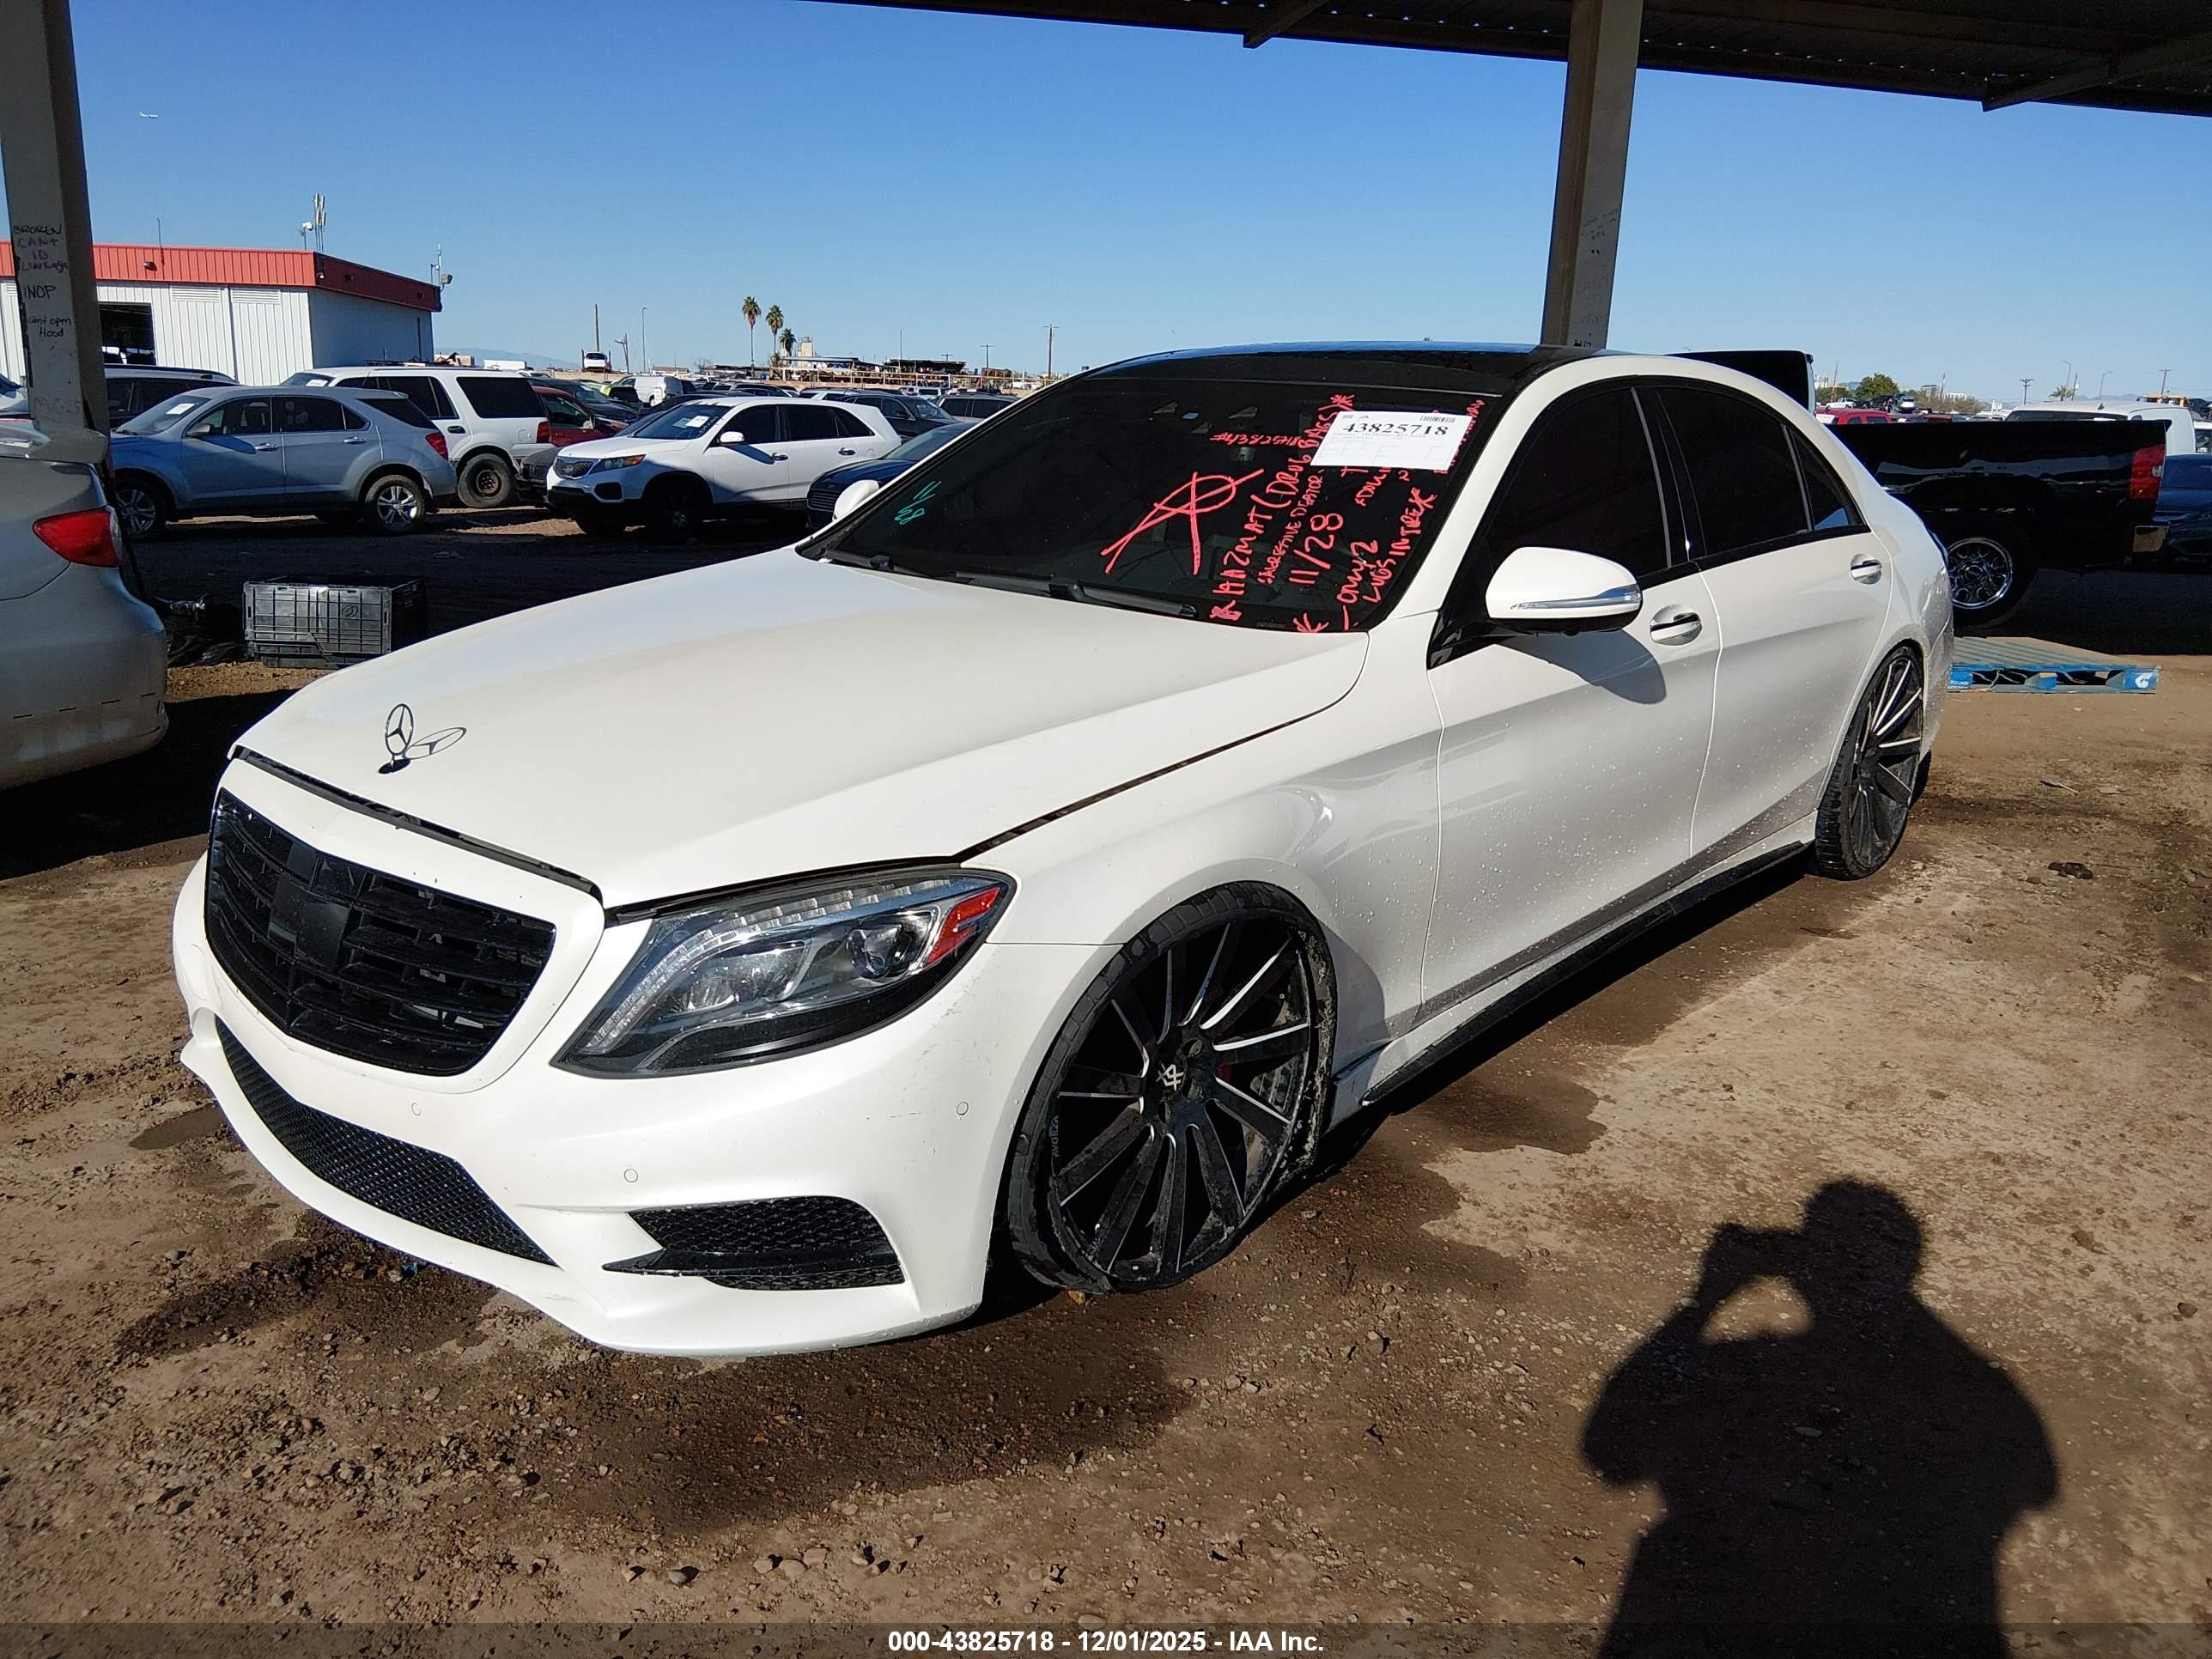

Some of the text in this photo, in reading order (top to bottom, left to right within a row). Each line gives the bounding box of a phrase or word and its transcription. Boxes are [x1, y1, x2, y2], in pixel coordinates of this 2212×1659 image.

[24, 284, 56, 299] INOP
[40, 326, 64, 337] Hood
[1343, 422, 1449, 436] 43825718
[1289, 513, 1344, 584] 11/28
